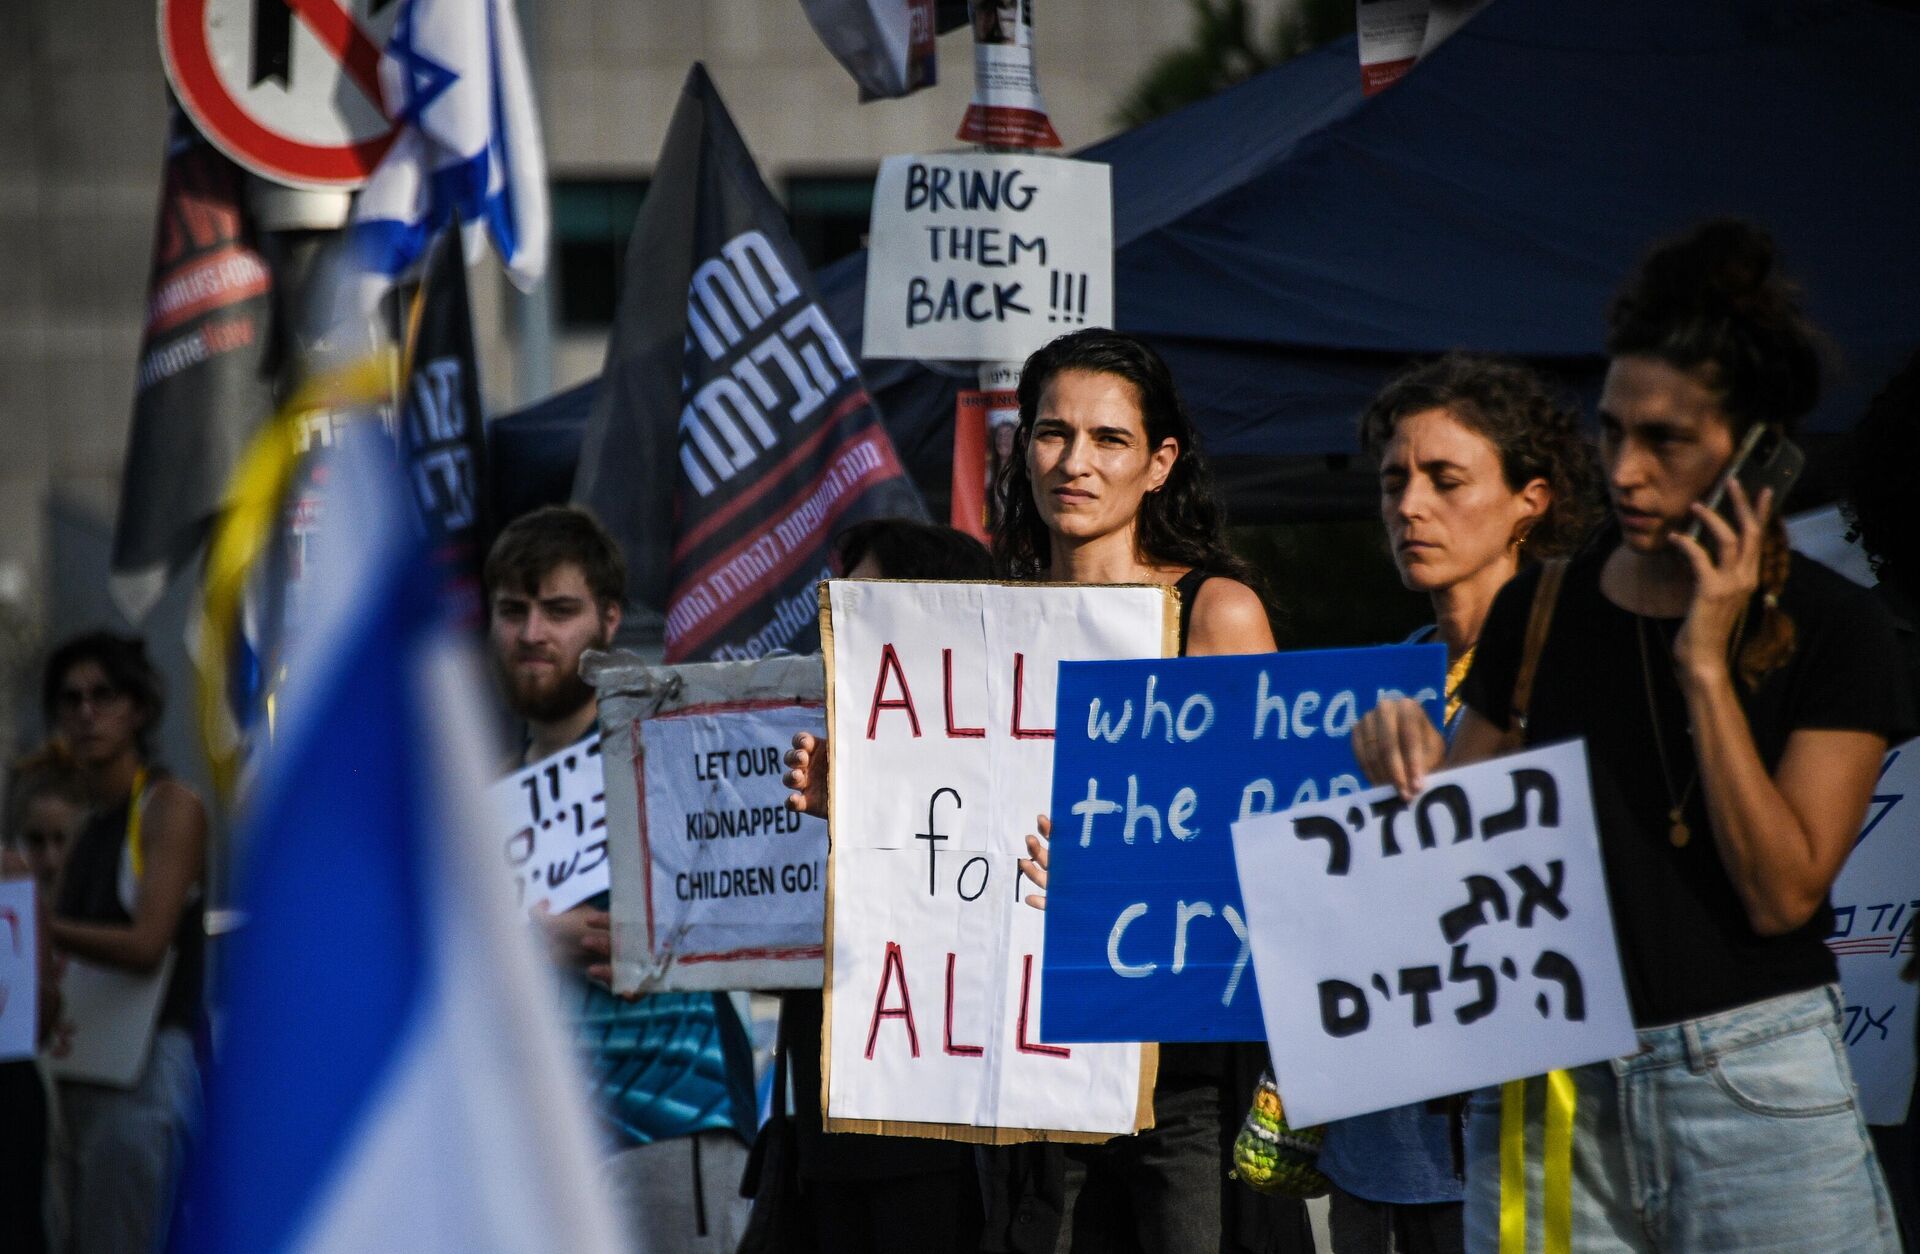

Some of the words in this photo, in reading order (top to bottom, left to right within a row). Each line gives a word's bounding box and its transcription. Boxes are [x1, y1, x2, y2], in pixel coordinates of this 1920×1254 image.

[905, 163, 1038, 213] BRING
[925, 225, 1047, 267] THEM
[906, 276, 1031, 328] BACK
[678, 303, 858, 497] הביתה
[865, 643, 1056, 740] ALL
[1087, 674, 1217, 744] who
[1252, 669, 1438, 741] hea
[695, 751, 730, 781] LET
[736, 747, 781, 778] OUR
[685, 805, 801, 842] KIDNAPPED
[1071, 774, 1202, 849] the
[1289, 768, 1561, 877] תחזיר
[676, 865, 776, 902] CHILDREN
[781, 860, 819, 894] GO!
[1438, 859, 1571, 945] את
[1106, 899, 1251, 1008] cry
[1317, 943, 1586, 1039] הילדים
[863, 940, 1071, 1060] ALL
